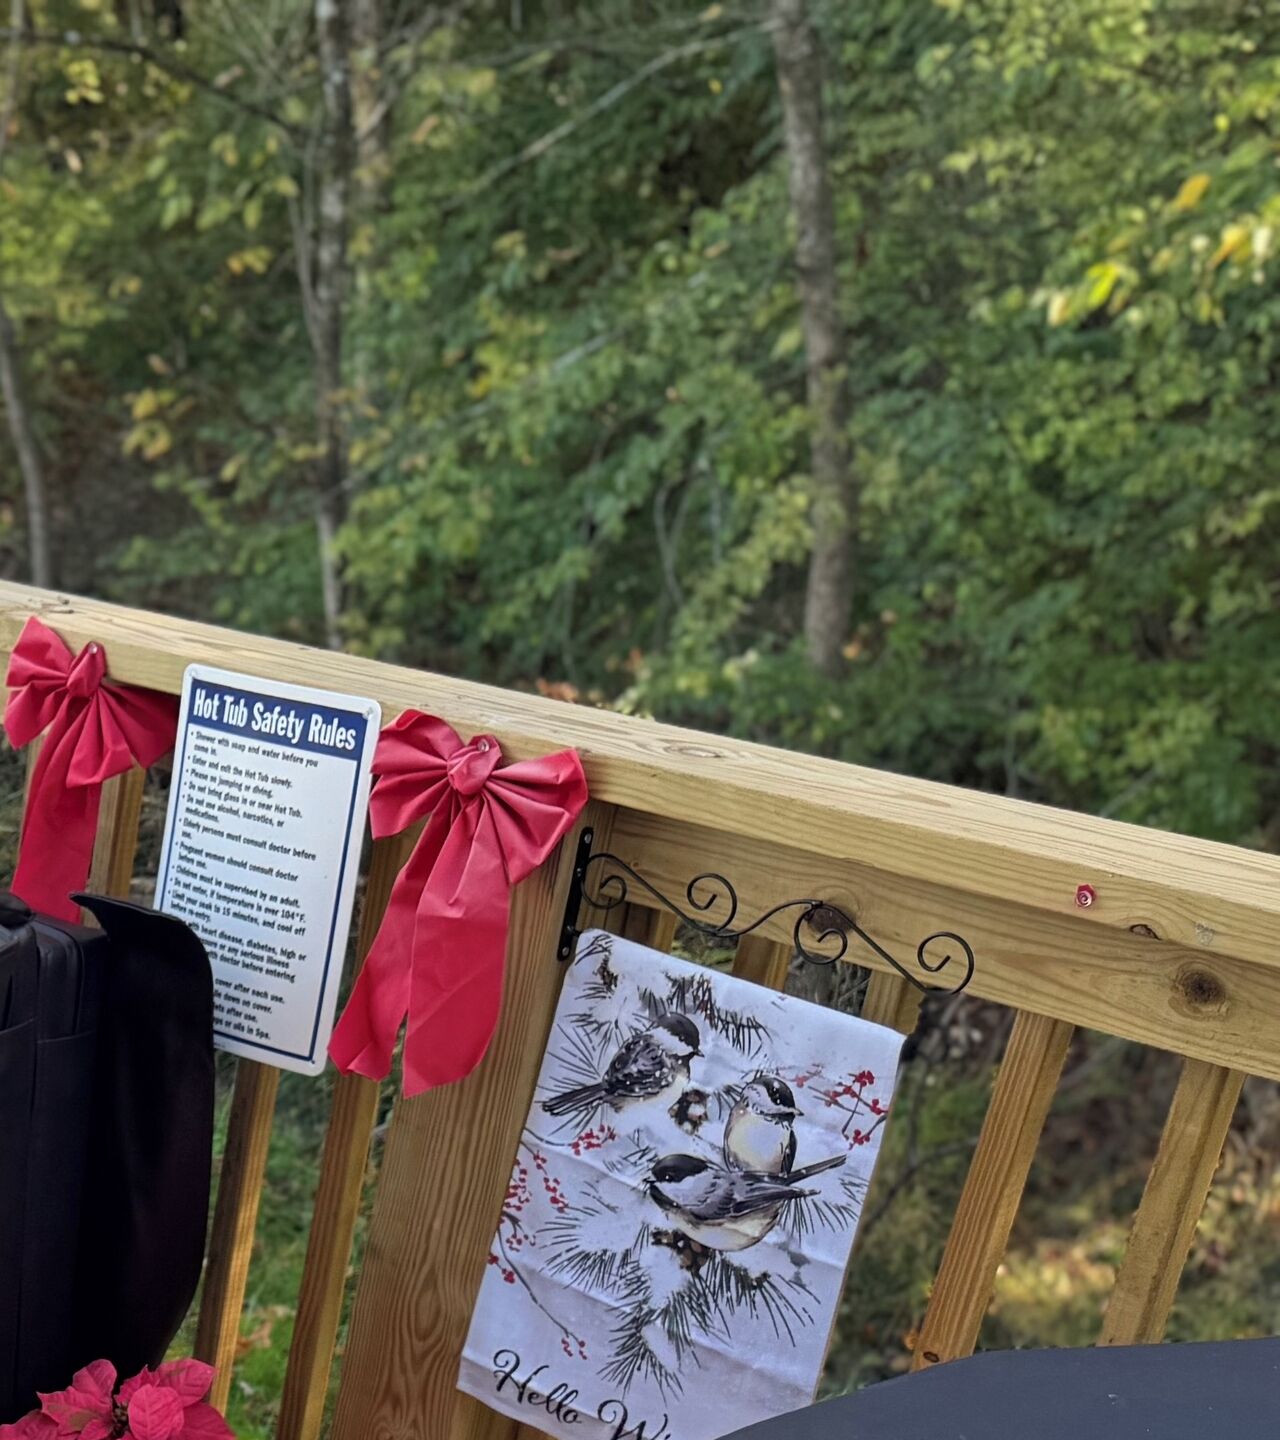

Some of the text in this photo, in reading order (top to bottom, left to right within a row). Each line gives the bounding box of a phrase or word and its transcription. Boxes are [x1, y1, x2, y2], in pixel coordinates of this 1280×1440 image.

[194, 689, 356, 750] Hot Tub Safety Rules
[493, 1349, 582, 1424] Hello
